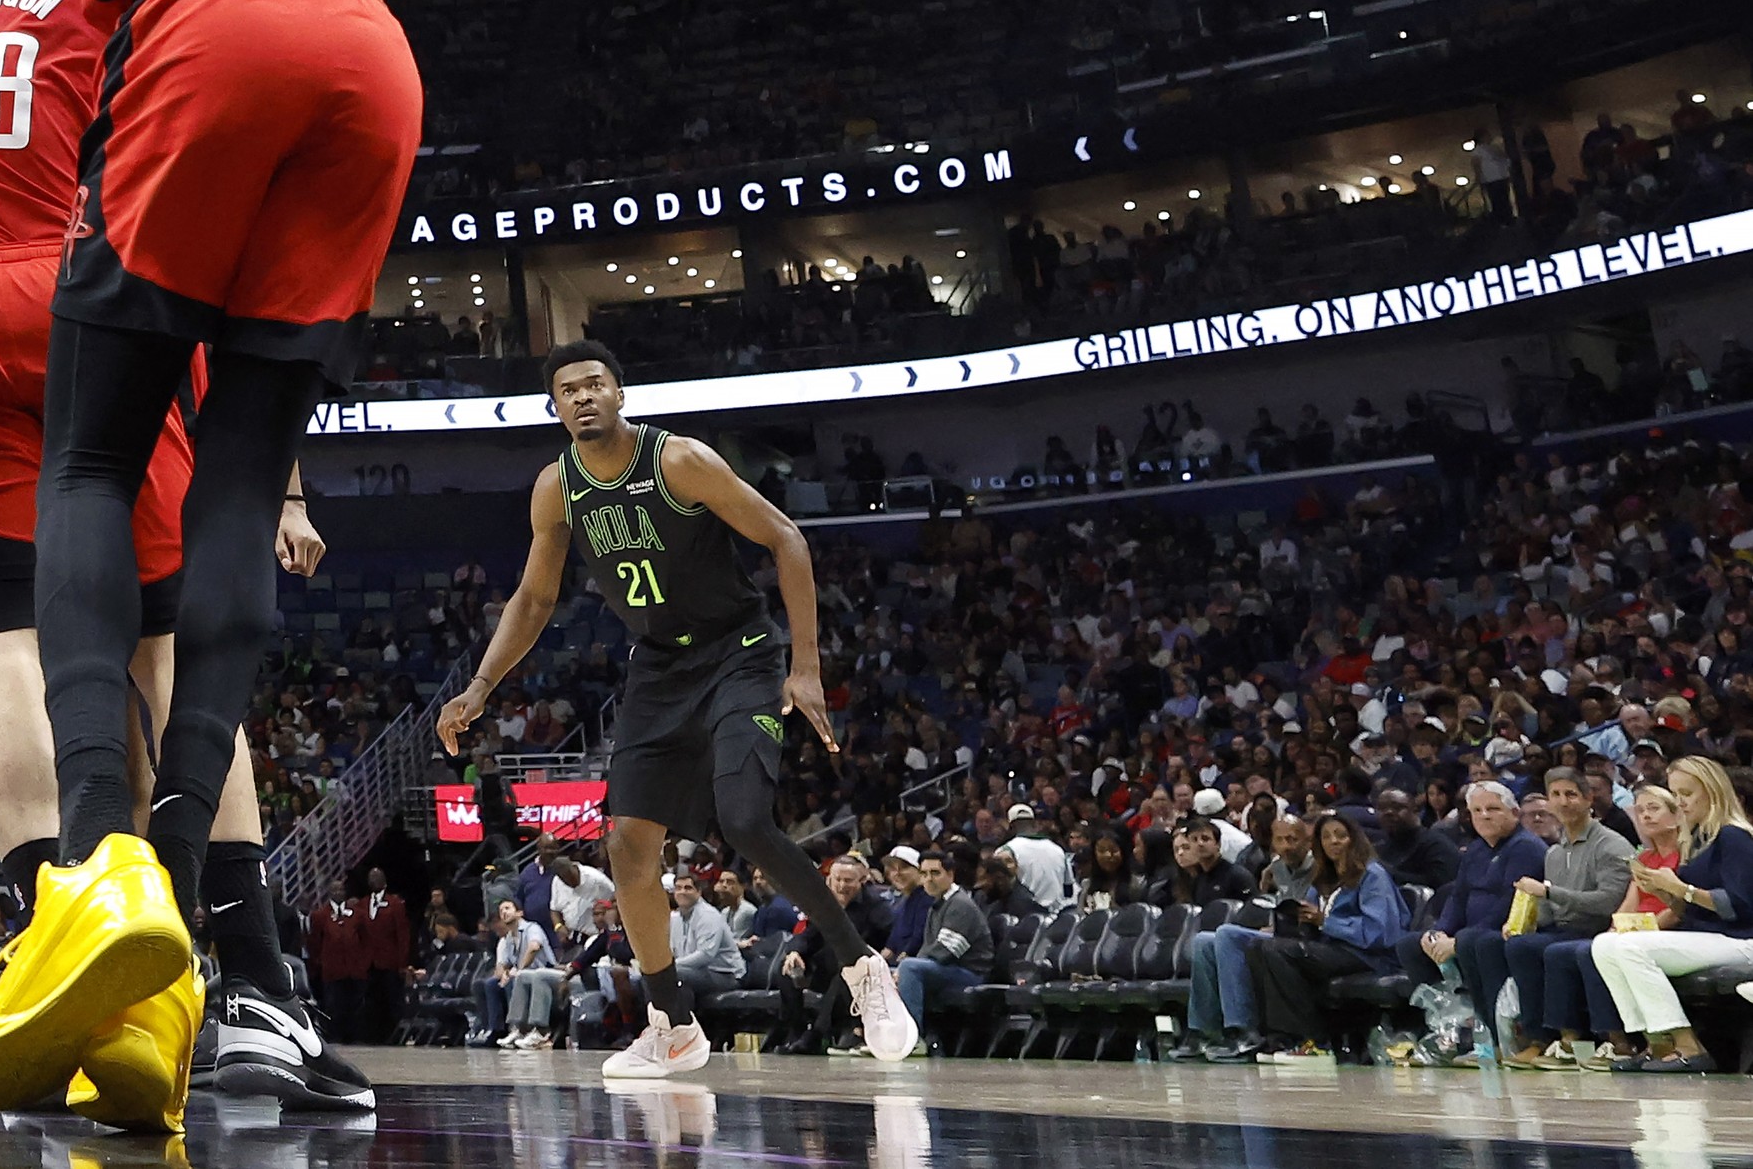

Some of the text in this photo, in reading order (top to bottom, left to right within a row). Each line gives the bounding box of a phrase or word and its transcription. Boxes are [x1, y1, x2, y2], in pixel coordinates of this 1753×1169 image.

[410, 149, 1012, 243] AGEPRODUCTS.COM
[1073, 223, 1726, 371] GRILLING. ON ANOTHER LEVEL.
[312, 400, 392, 432] VEL.
[353, 463, 412, 497] 120
[581, 504, 666, 558] NOLA
[616, 559, 666, 607] 21
